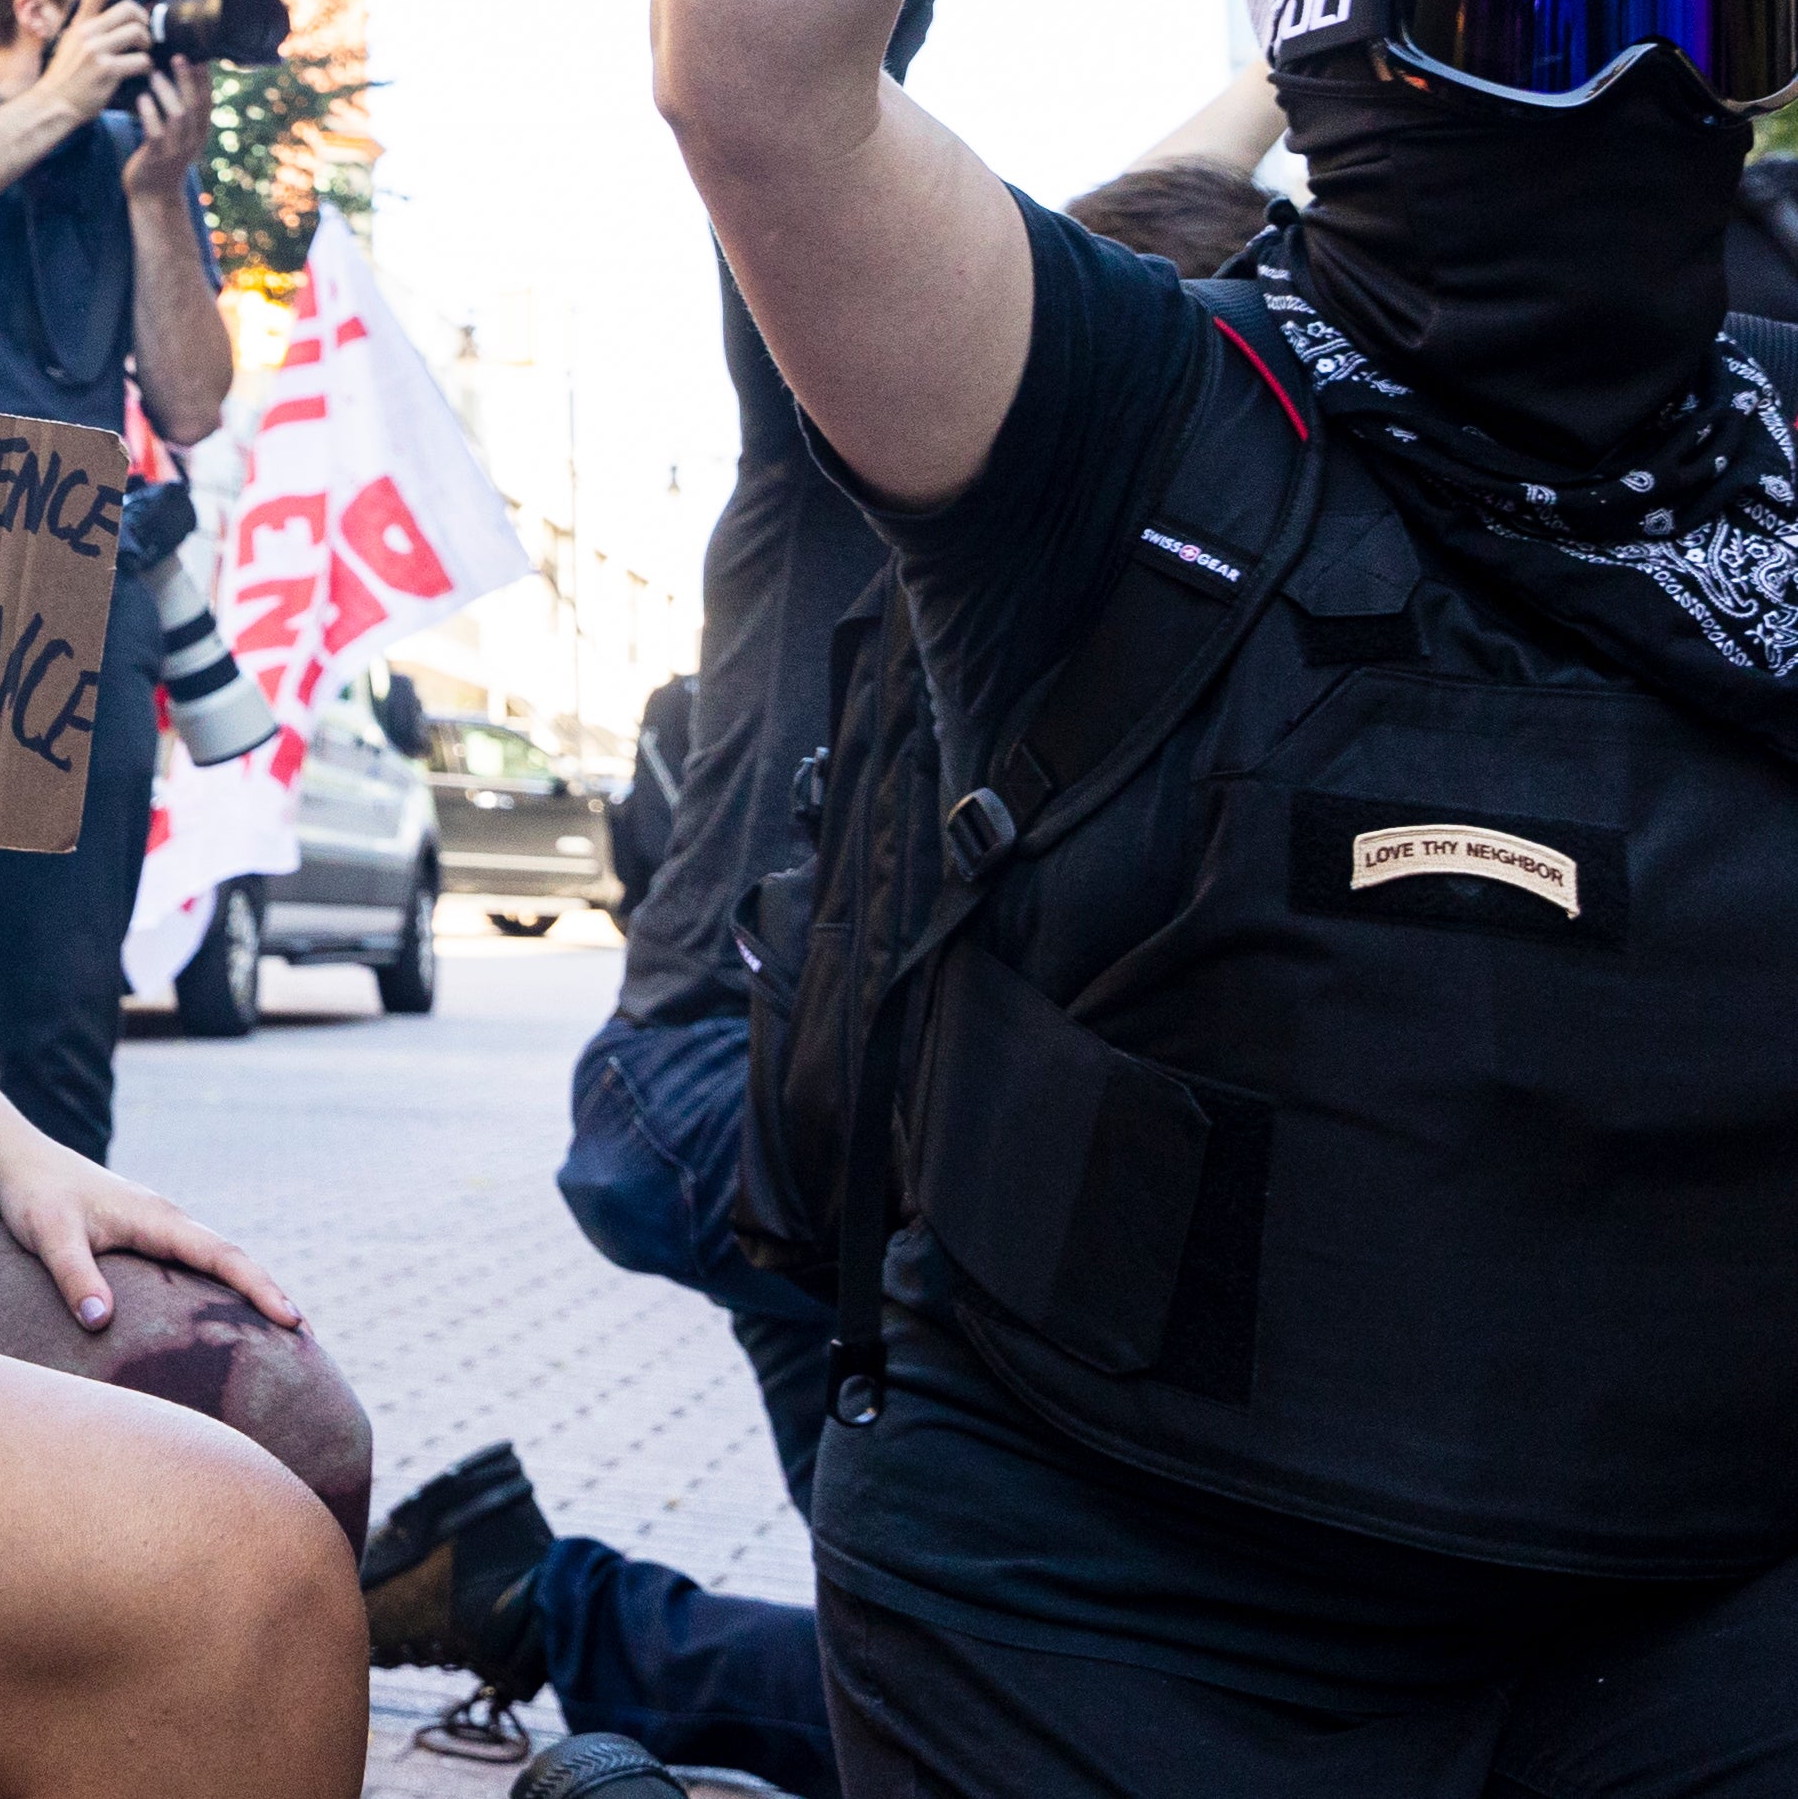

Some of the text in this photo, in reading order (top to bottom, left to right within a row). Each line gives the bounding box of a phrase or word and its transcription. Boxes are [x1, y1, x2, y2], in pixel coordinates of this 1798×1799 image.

[1141, 528, 1241, 582] SWISS GEAR
[1365, 841, 1564, 887] LOVE THY NEIGHBOR
